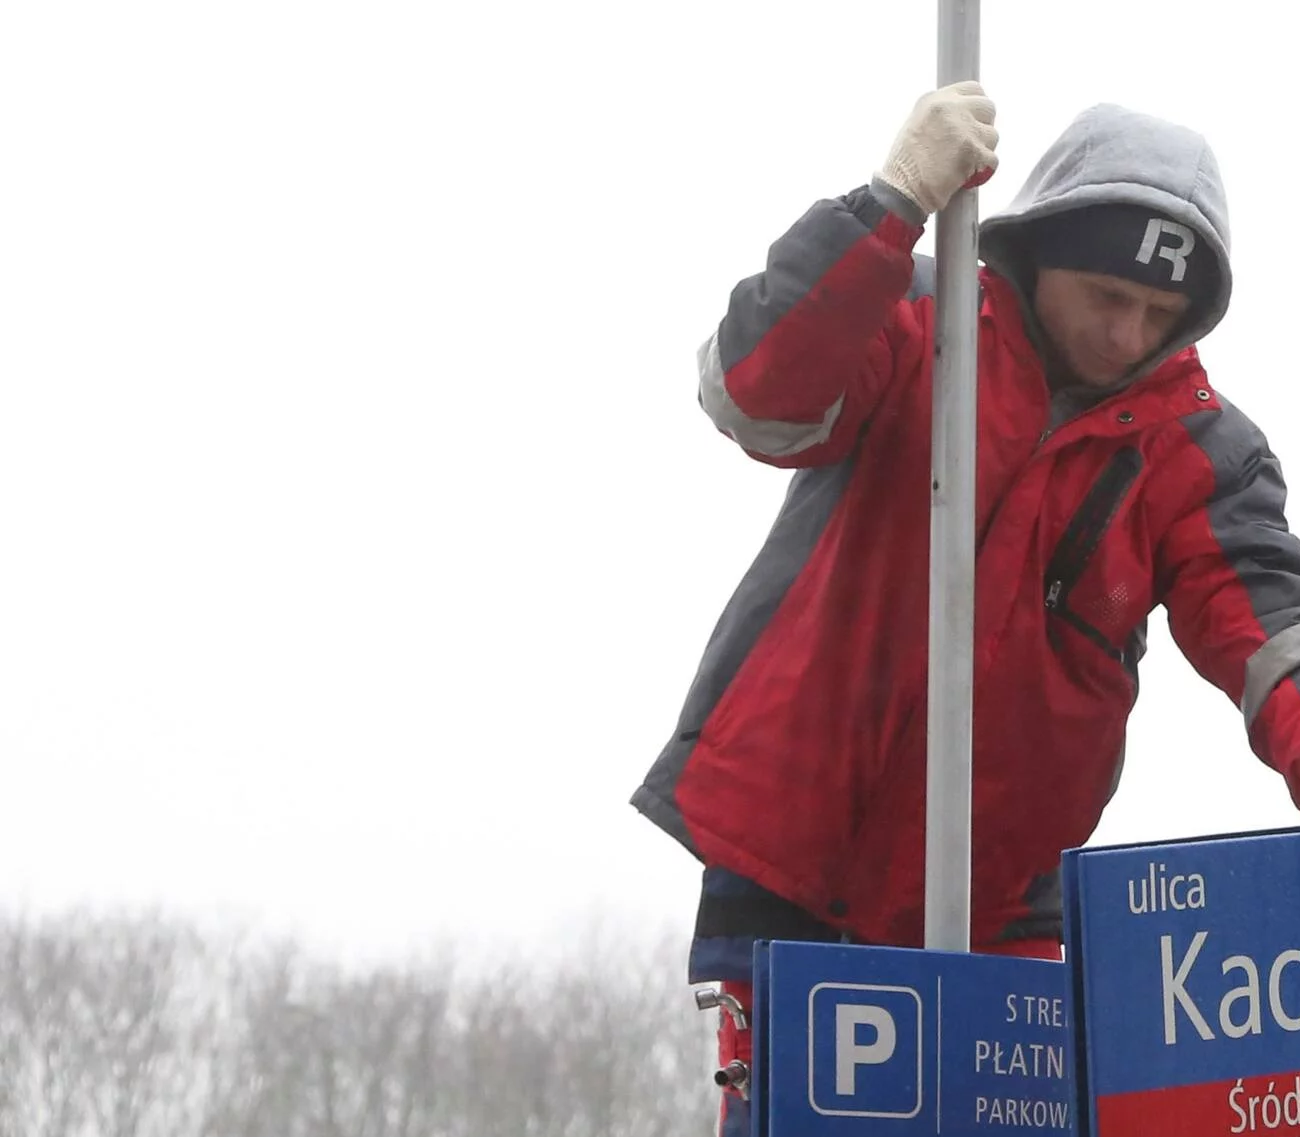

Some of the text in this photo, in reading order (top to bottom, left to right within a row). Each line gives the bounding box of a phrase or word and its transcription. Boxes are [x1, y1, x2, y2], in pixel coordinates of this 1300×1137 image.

[1135, 218, 1195, 281] R
[1127, 862, 1206, 914] ulica
[1006, 994, 1068, 1027] STRE
[835, 1003, 897, 1096] P
[975, 1040, 1063, 1079] PŁATN
[975, 1096, 1072, 1129] PARKOW
